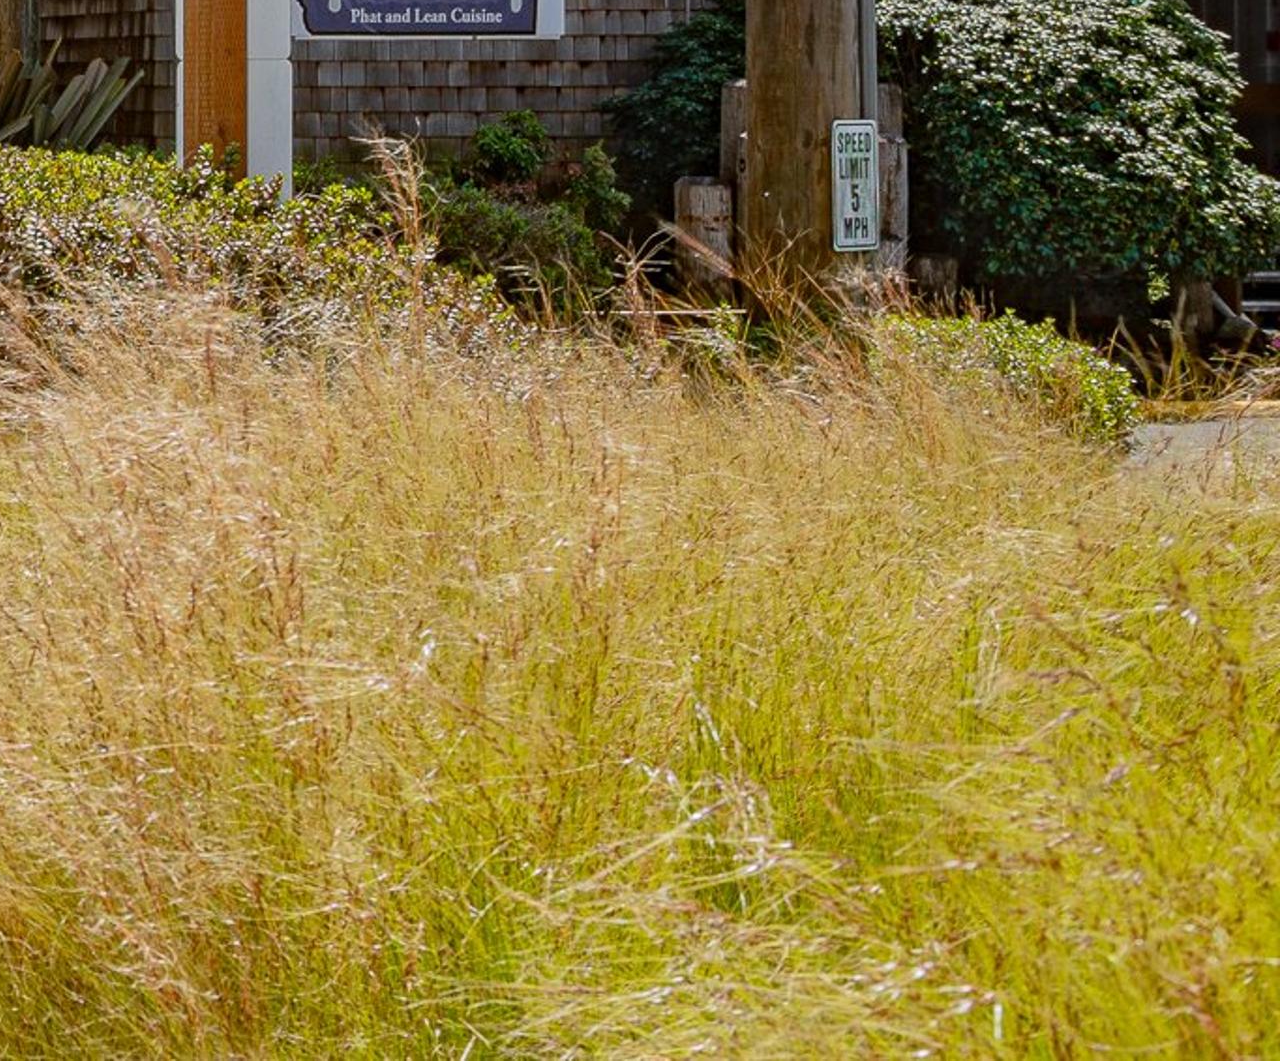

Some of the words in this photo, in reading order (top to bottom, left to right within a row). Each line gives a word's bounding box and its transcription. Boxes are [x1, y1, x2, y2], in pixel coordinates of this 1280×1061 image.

[351, 8, 384, 25] Phat
[385, 8, 412, 24] and
[415, 8, 447, 24] Lean
[450, 7, 503, 24] Cuisine
[837, 132, 872, 154] SPEED
[839, 157, 870, 180] LIMIT
[851, 185, 861, 213] 5
[844, 217, 869, 239] MPH
